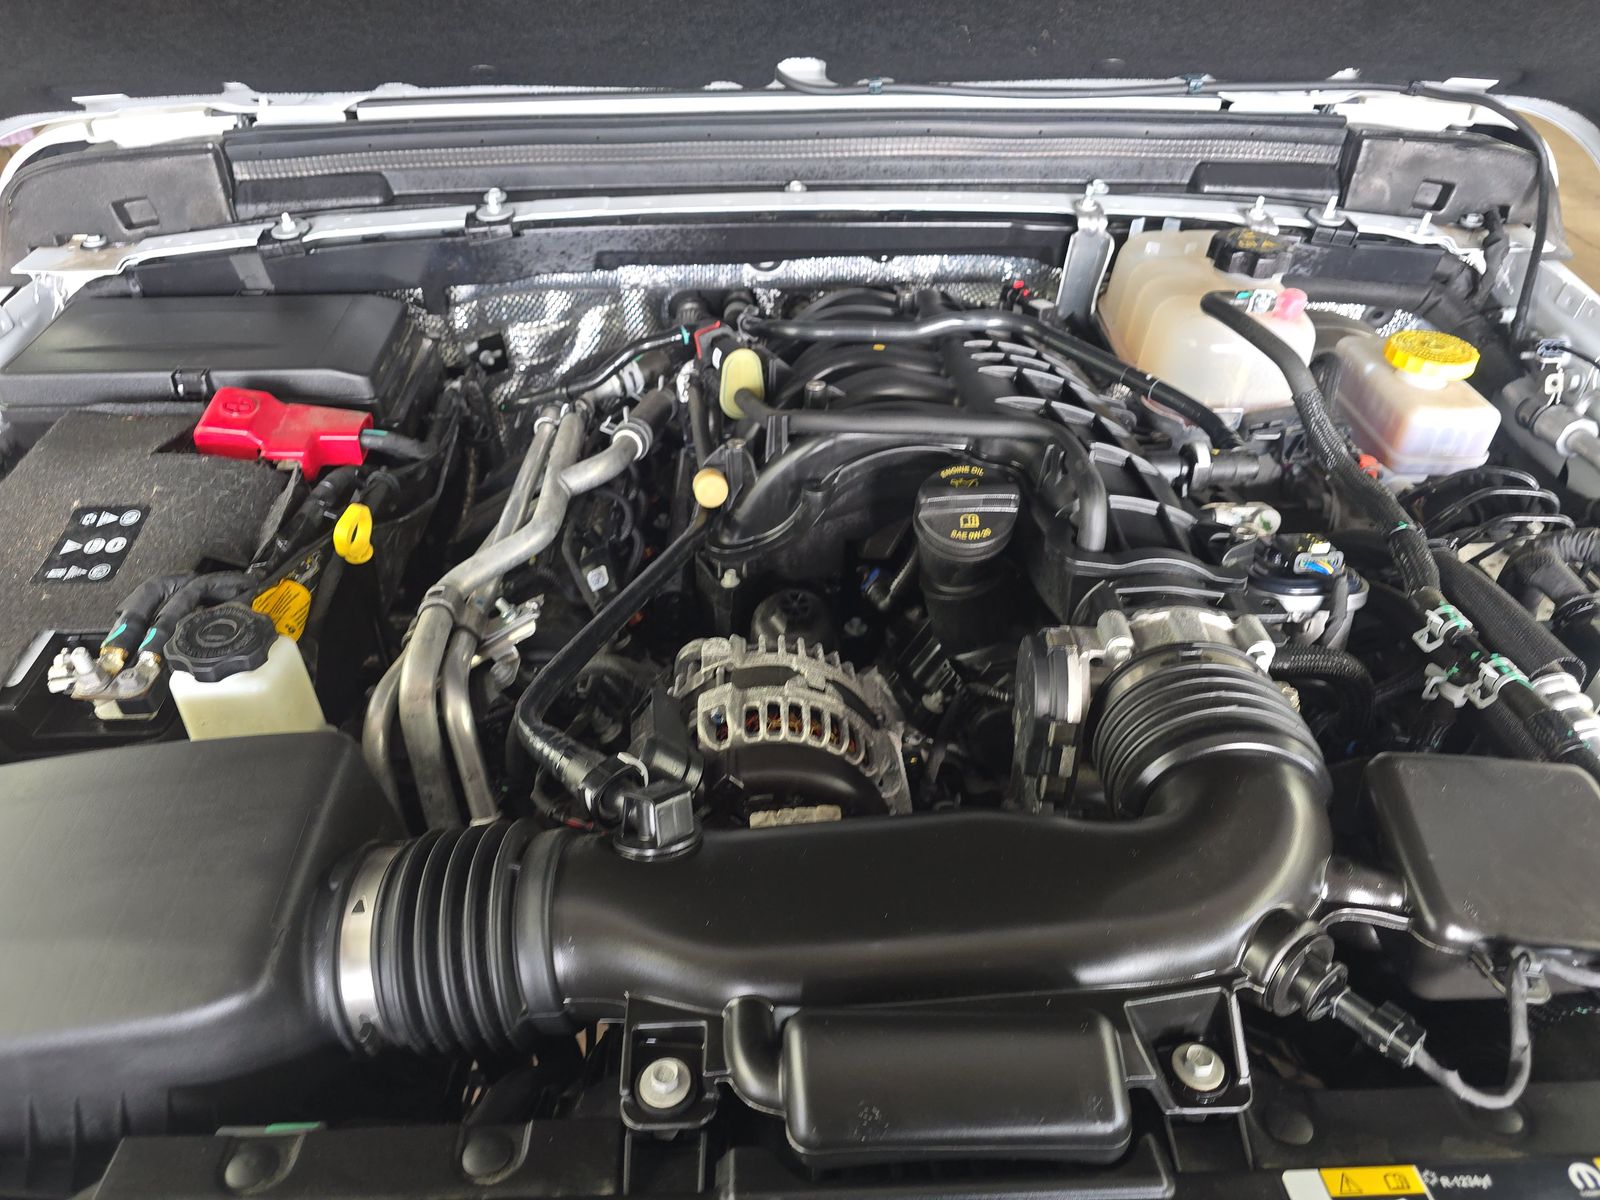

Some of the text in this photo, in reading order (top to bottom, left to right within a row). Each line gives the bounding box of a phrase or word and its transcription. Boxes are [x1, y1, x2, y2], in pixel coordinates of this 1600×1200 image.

[940, 465, 984, 478] ENGINE OIL
[950, 529, 967, 540] SAE
